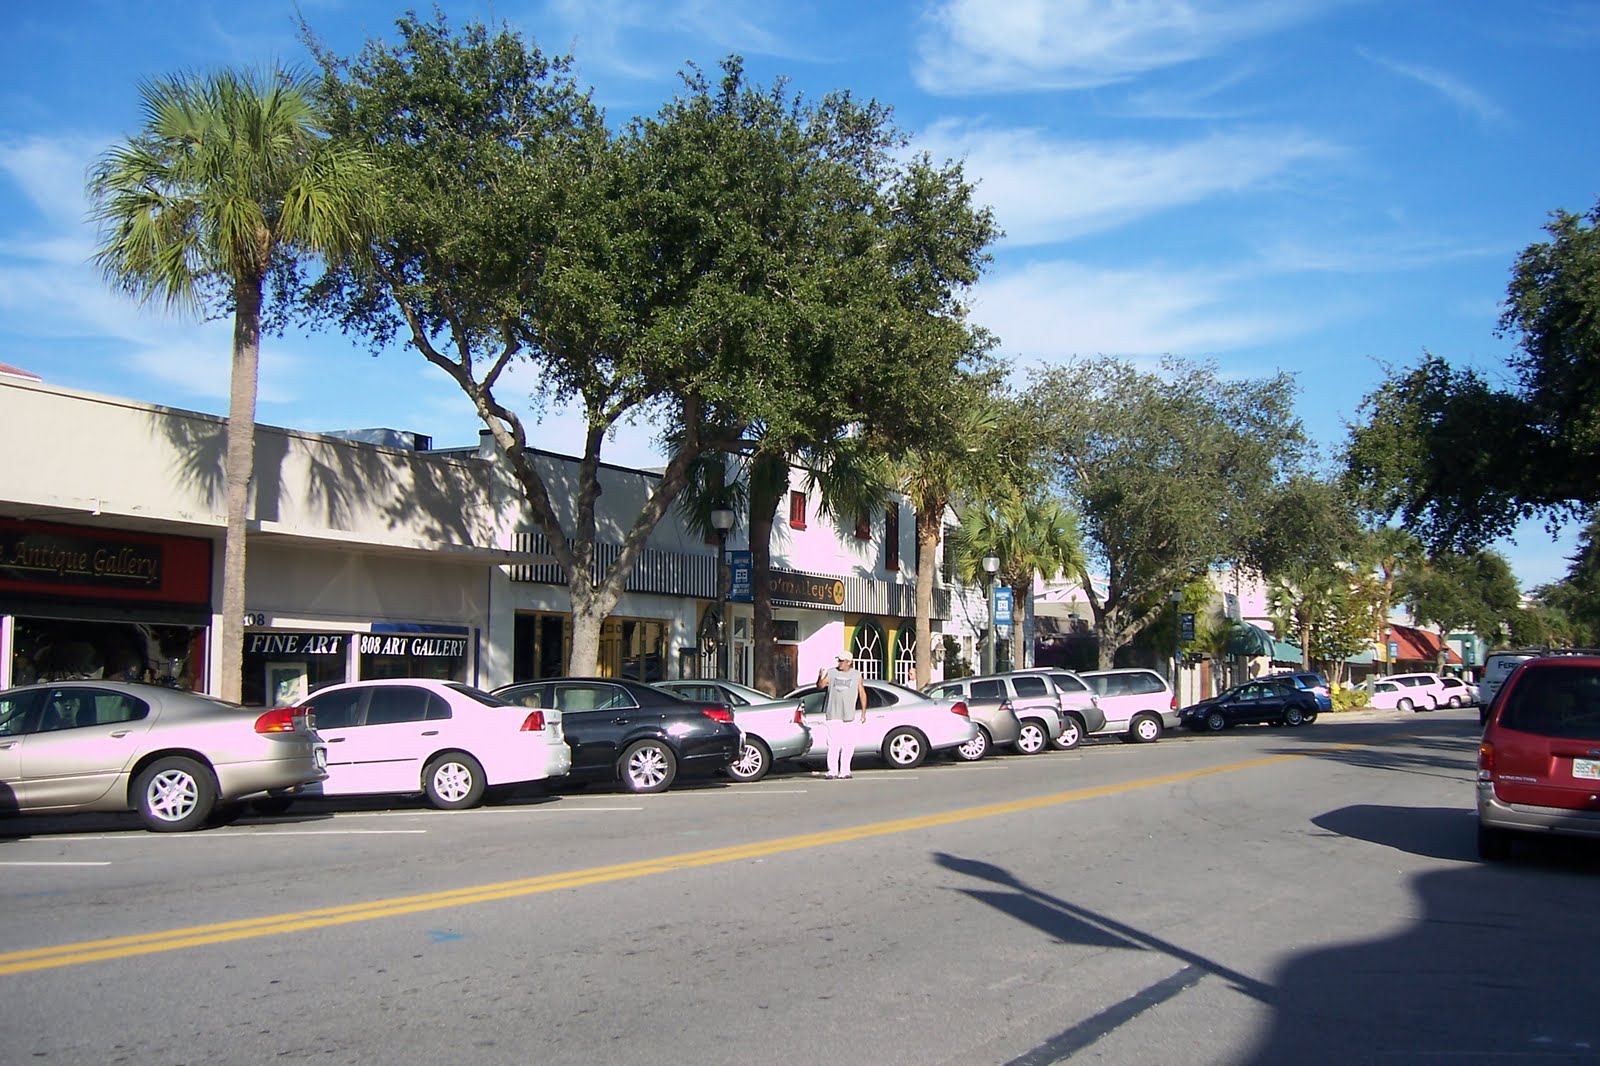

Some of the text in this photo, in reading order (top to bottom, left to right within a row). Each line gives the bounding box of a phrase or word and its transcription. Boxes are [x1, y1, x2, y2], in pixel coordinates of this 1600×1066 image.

[10, 541, 158, 584] Antique Gallery
[250, 634, 343, 654] FINE ART
[361, 636, 467, 657] 808 ART GALLERY
